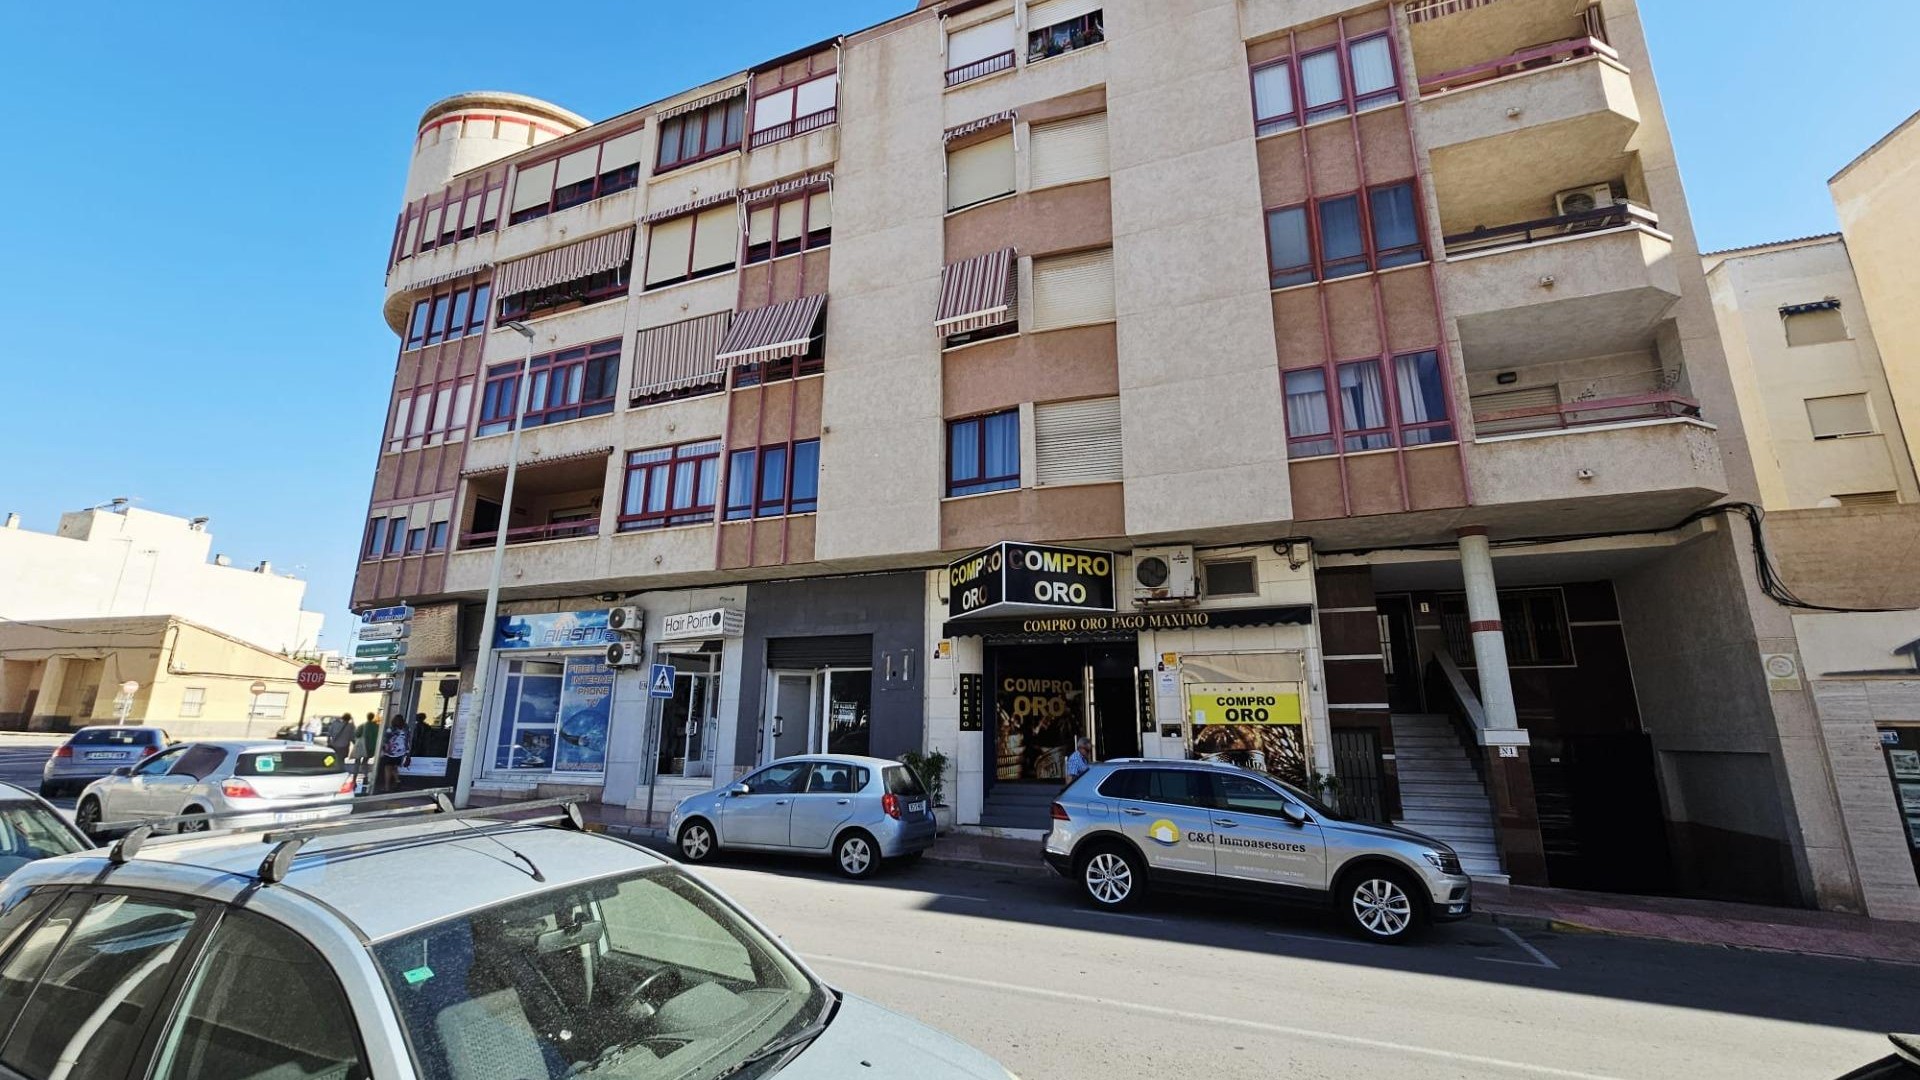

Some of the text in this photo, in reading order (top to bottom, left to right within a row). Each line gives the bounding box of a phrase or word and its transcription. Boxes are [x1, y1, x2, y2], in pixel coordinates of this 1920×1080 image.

[951, 550, 1001, 587] COMPRO
[1008, 549, 1110, 577] COMPRO
[962, 585, 988, 610] ORO
[1034, 581, 1087, 604] ORO
[665, 616, 685, 632] Hair
[687, 612, 712, 630] Point
[1023, 612, 1209, 633] COMPRO ORO PAGO MAXIMO
[300, 671, 325, 683] STOP
[1003, 678, 1073, 693] COMPRO
[576, 686, 609, 695] PHONE
[1013, 695, 1065, 717] ORO
[1216, 696, 1276, 707] COMPRO
[1225, 708, 1269, 722] ORO
[1188, 832, 1215, 843] C&C
[1219, 834, 1306, 853] Inmoasesores
